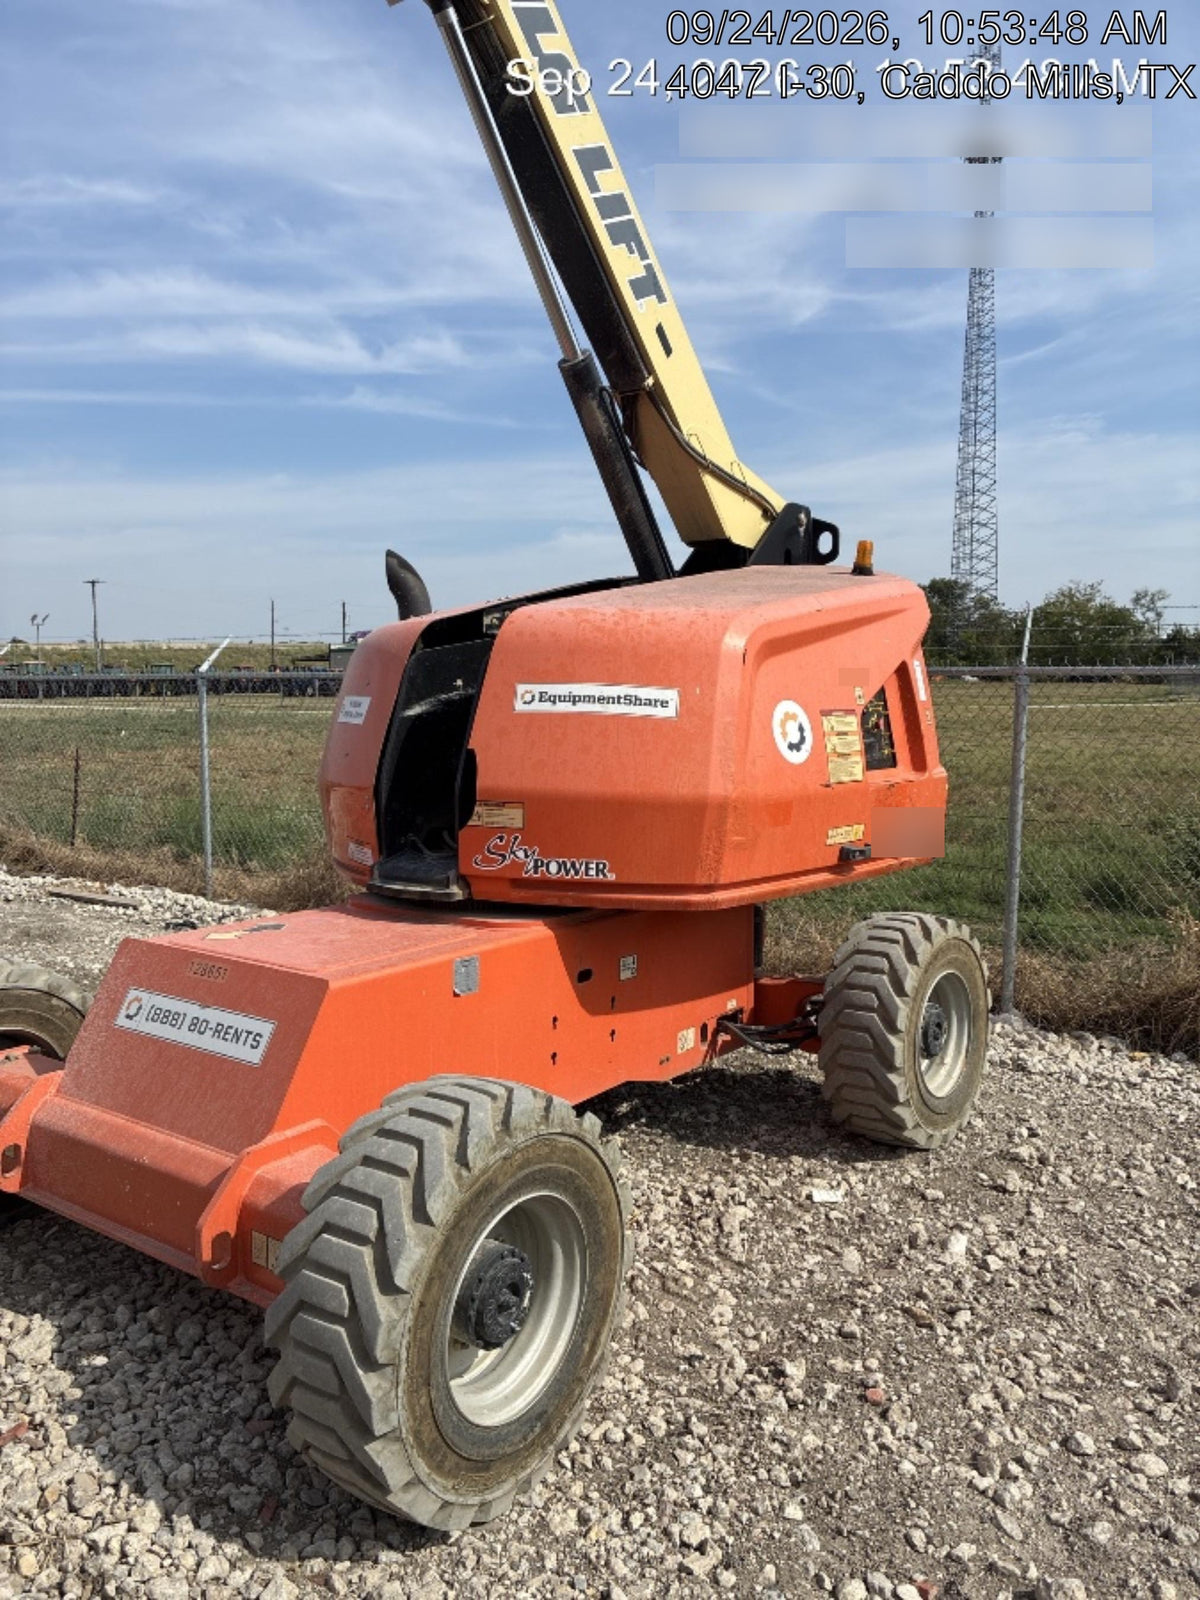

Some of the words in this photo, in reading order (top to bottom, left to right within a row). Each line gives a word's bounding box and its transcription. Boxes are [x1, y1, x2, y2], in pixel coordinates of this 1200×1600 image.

[511, 0, 592, 117] LG
[570, 144, 668, 305] LIFT
[538, 691, 670, 709] EquipmentShare
[473, 834, 539, 876] Sky
[145, 1003, 188, 1030] (888)
[187, 1016, 264, 1050] 80-RENTS
